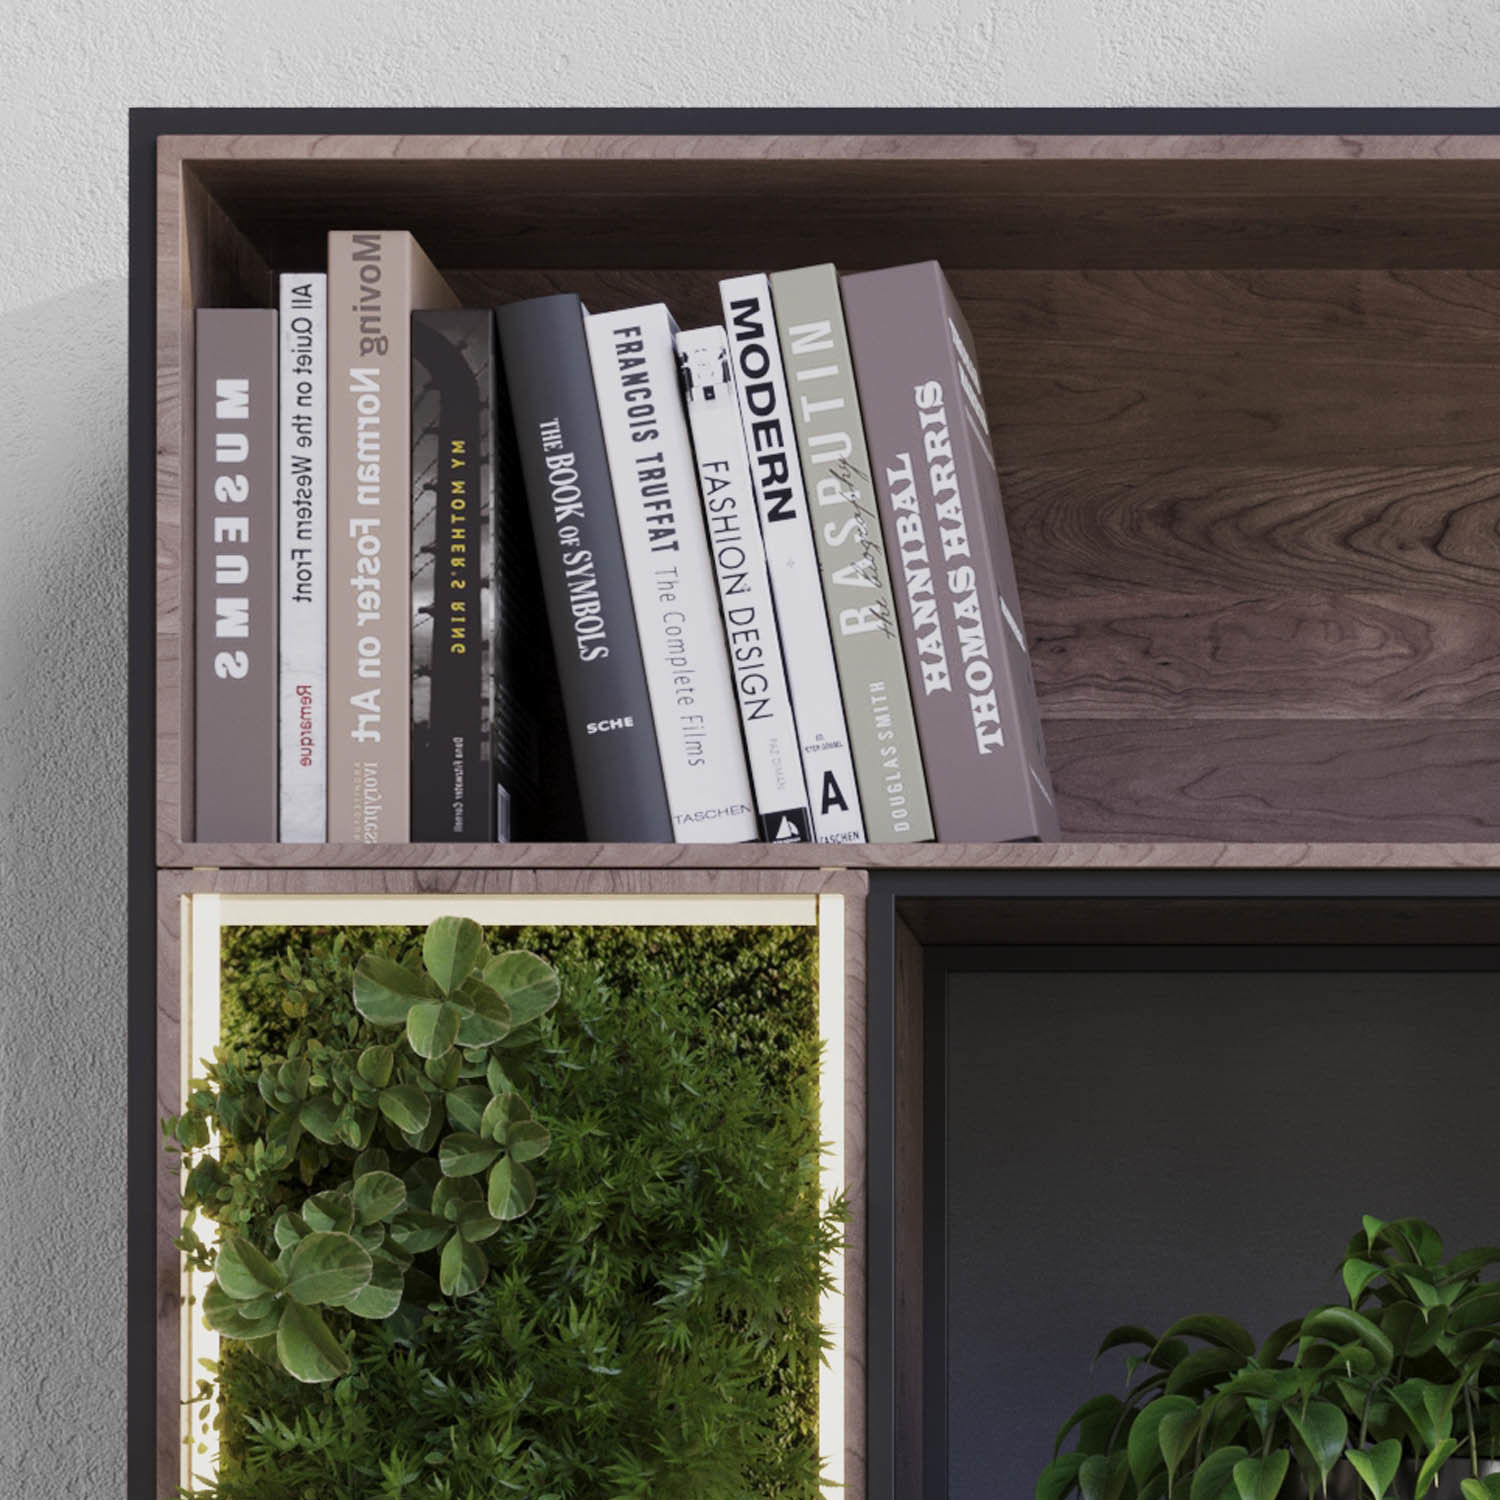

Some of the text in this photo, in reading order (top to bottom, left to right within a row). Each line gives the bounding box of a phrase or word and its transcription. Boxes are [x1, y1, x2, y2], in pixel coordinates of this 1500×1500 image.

[730, 297, 797, 523] MODERN
[789, 320, 886, 636] RASPUTIN
[539, 417, 608, 661] THE BOOK OF SYMBOLS
[613, 326, 707, 768] FRANCOIS TRUFFAT The Complete Films
[702, 461, 773, 721] FASHION DESIGN
[886, 452, 952, 696] HANNIBAL
[914, 380, 1004, 754] THOMAS HARRIS
[586, 716, 634, 735] SCHE
[674, 804, 752, 825] TASCHEN
[821, 771, 848, 815] A
[869, 681, 910, 832] DOUGLAS SMITH
